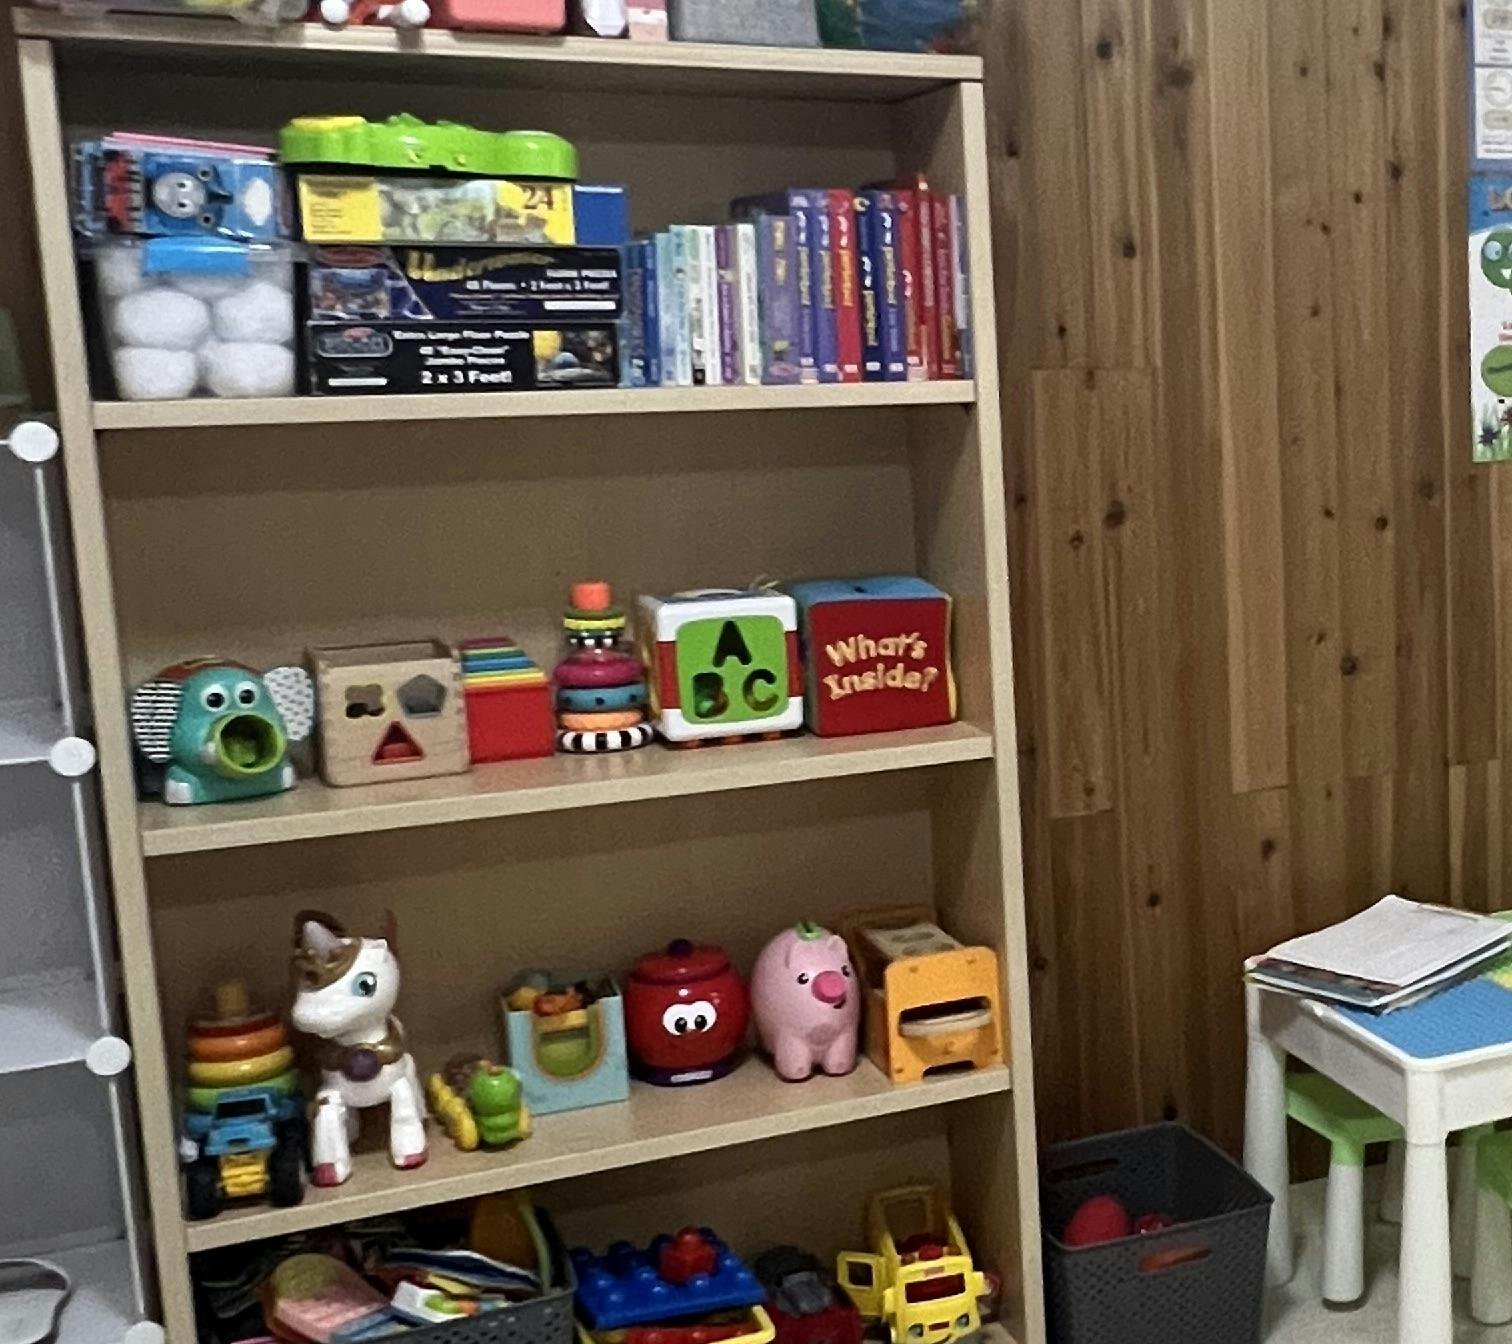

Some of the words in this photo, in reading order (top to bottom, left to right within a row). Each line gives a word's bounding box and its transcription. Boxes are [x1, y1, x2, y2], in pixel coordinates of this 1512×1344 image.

[420, 370, 433, 384] 2
[436, 373, 449, 384] x
[453, 370, 465, 384] 3
[712, 620, 752, 668] A
[825, 632, 928, 667] What's
[692, 670, 730, 719] B
[742, 668, 779, 712] C
[822, 662, 939, 701] Inside?
